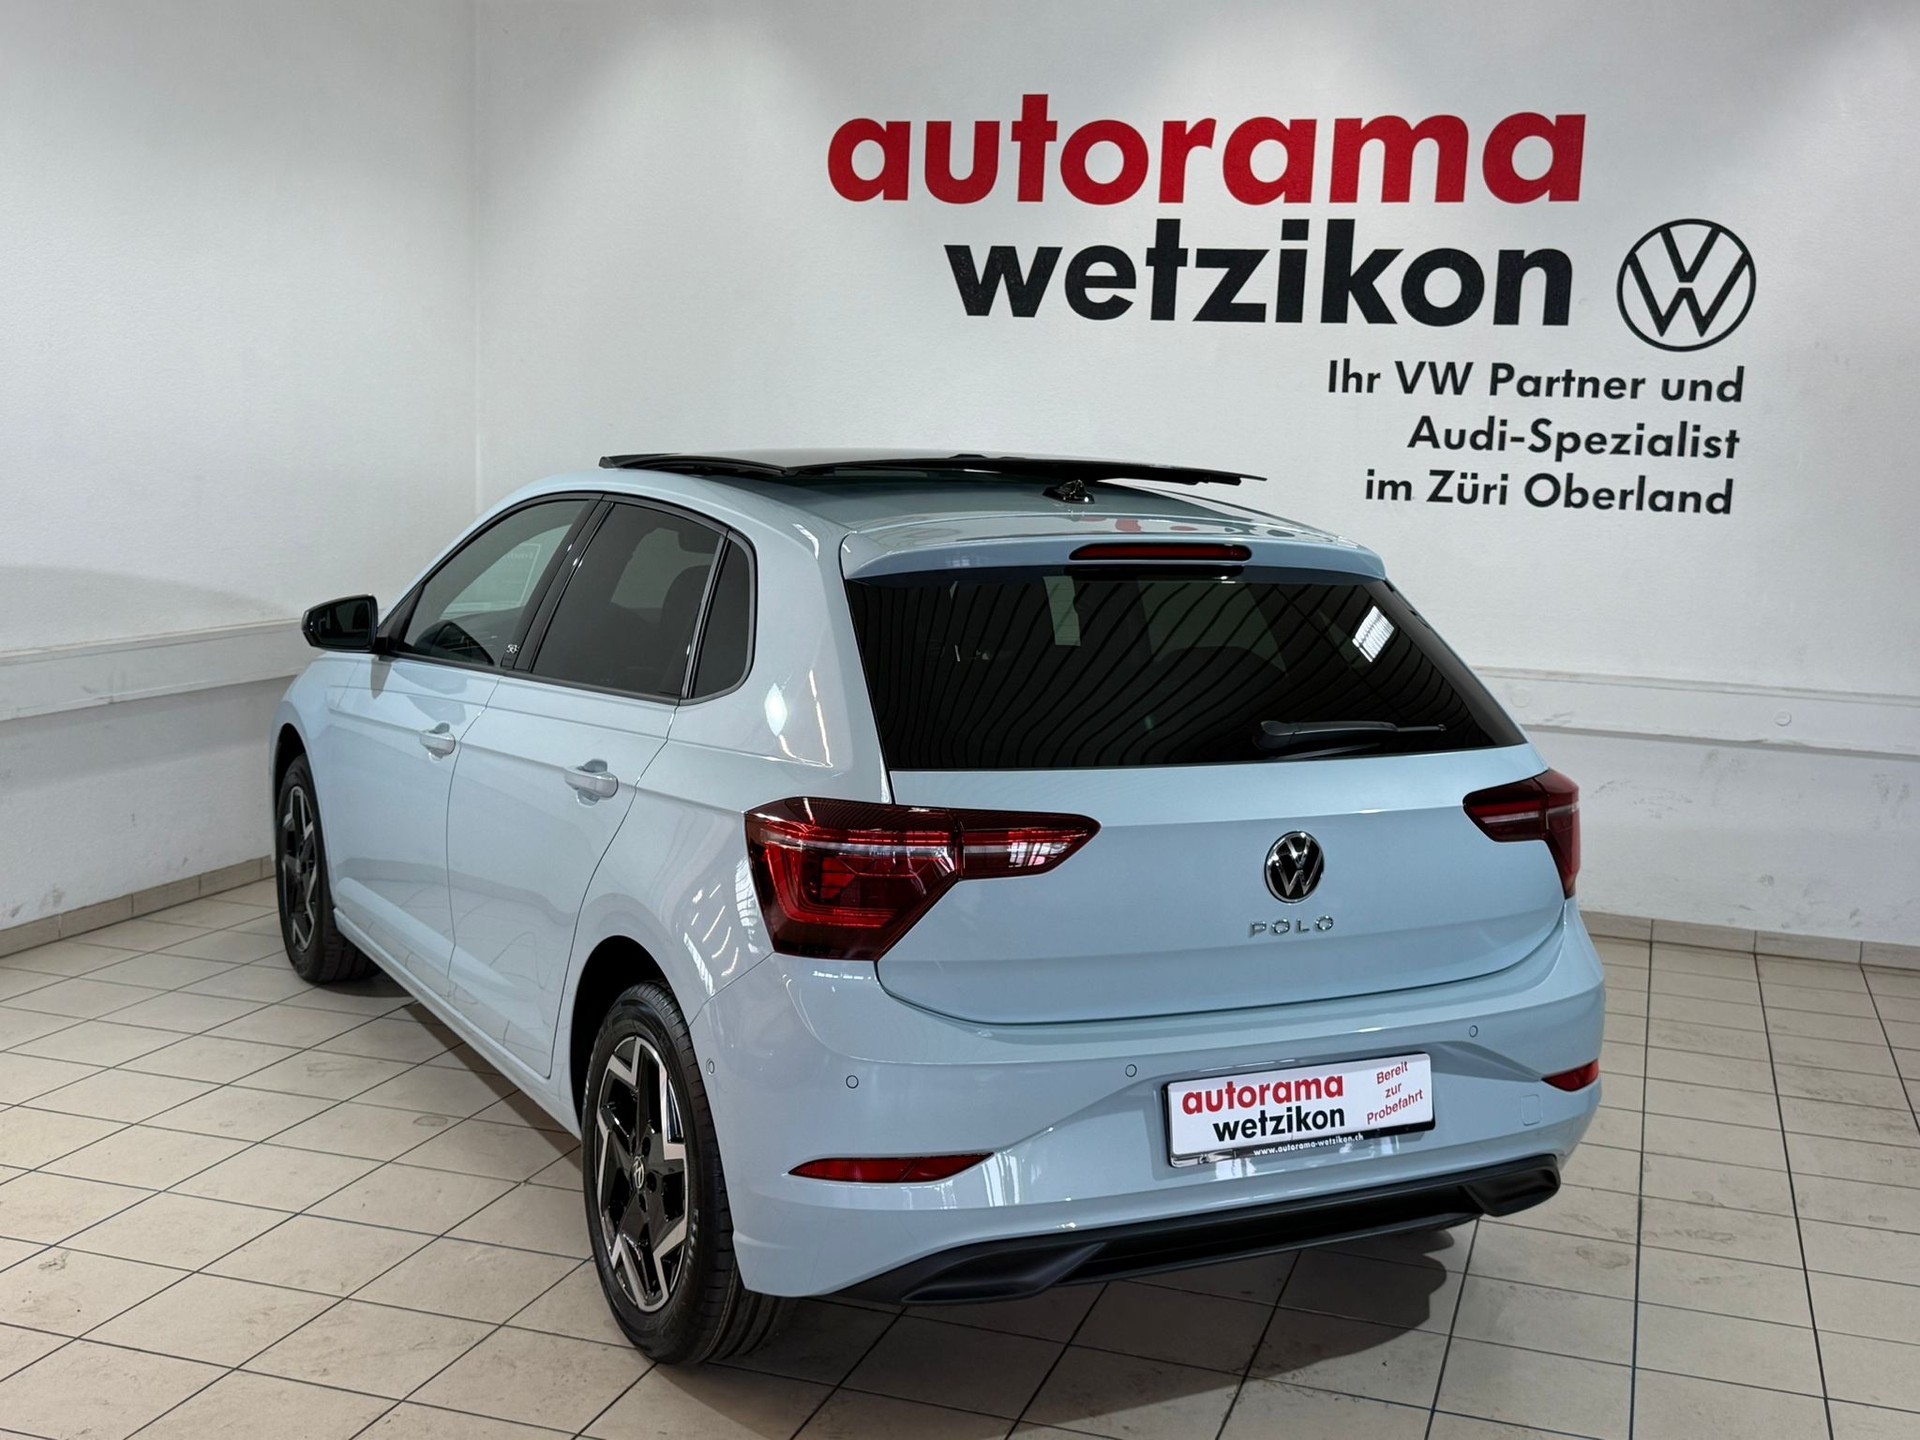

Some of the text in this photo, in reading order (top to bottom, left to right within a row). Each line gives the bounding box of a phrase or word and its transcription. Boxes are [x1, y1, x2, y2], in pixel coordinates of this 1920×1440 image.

[827, 94, 1587, 207] autorama
[943, 218, 1574, 327] wetzikon
[1328, 358, 1745, 403] Ihr VW Partner und
[1407, 415, 1740, 463] Audi-Spezialist
[1365, 468, 1734, 515] im Züri Oberland
[1248, 915, 1334, 938] POLO
[1376, 1061, 1409, 1085] Bereit
[1384, 1081, 1403, 1099] zur
[1182, 1075, 1344, 1115] autorama
[1366, 1088, 1424, 1125] Probefahrt
[1212, 1105, 1346, 1142] wetzikon
[1253, 1133, 1364, 1156] www.autorama-wetzikon.ch
